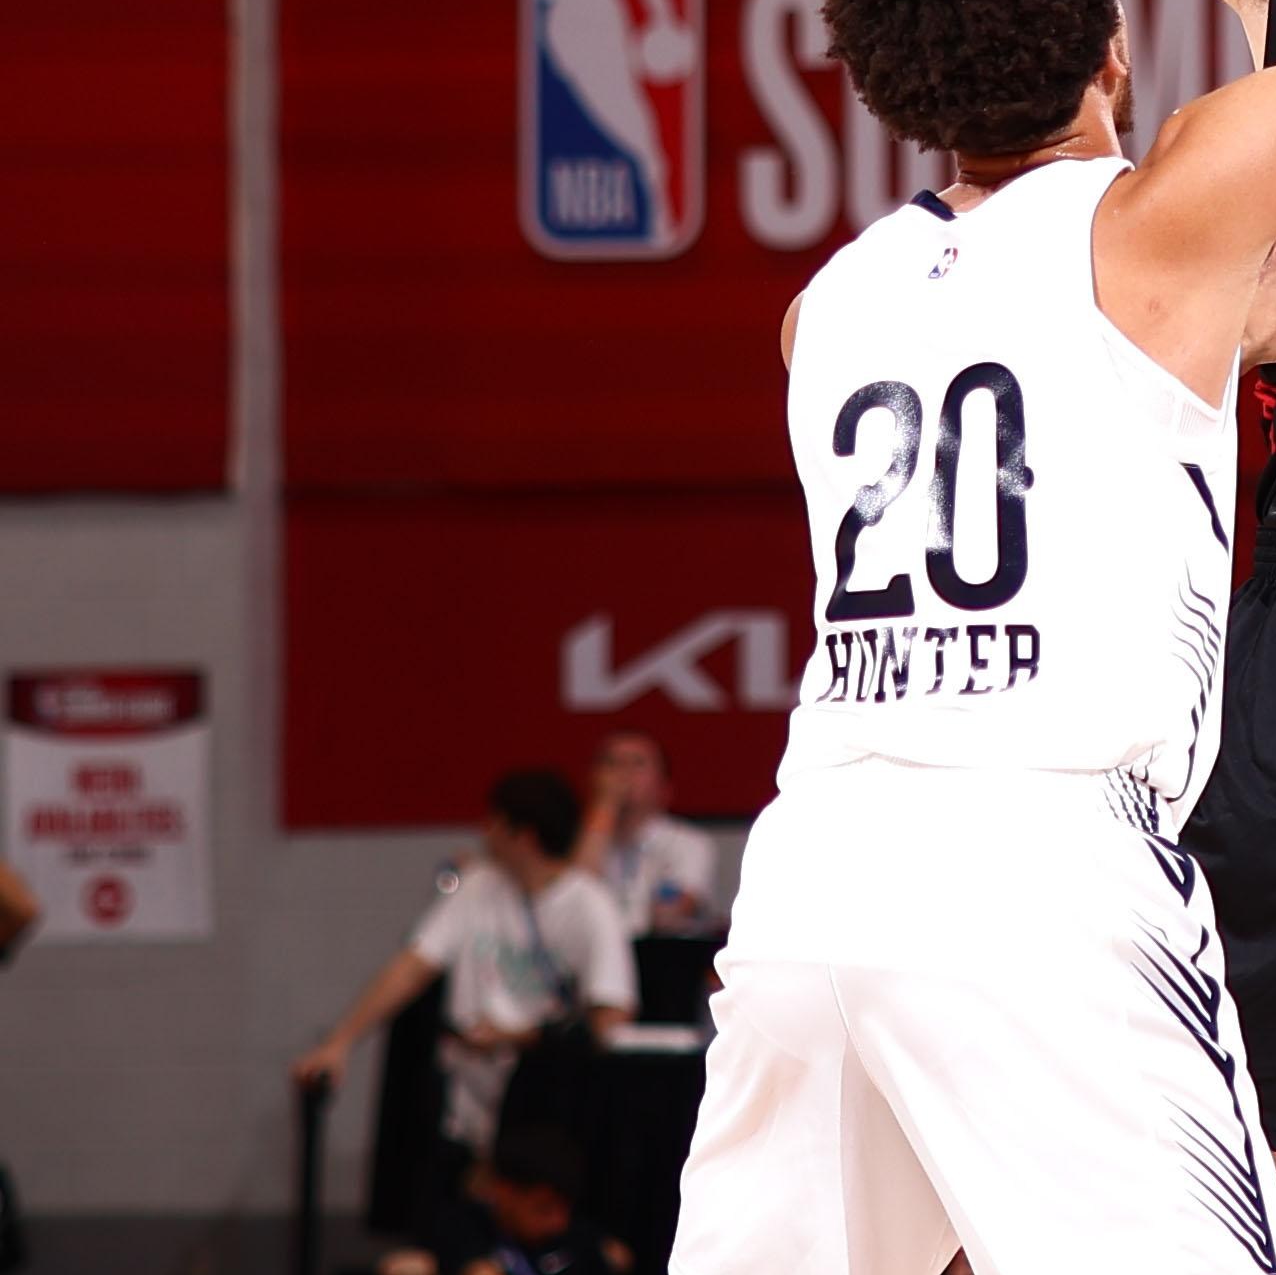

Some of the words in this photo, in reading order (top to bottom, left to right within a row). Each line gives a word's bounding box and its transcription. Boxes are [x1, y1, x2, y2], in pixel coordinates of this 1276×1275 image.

[825, 362, 1034, 622] 20
[562, 610, 801, 709] KI
[815, 624, 1041, 703] HUNTER
